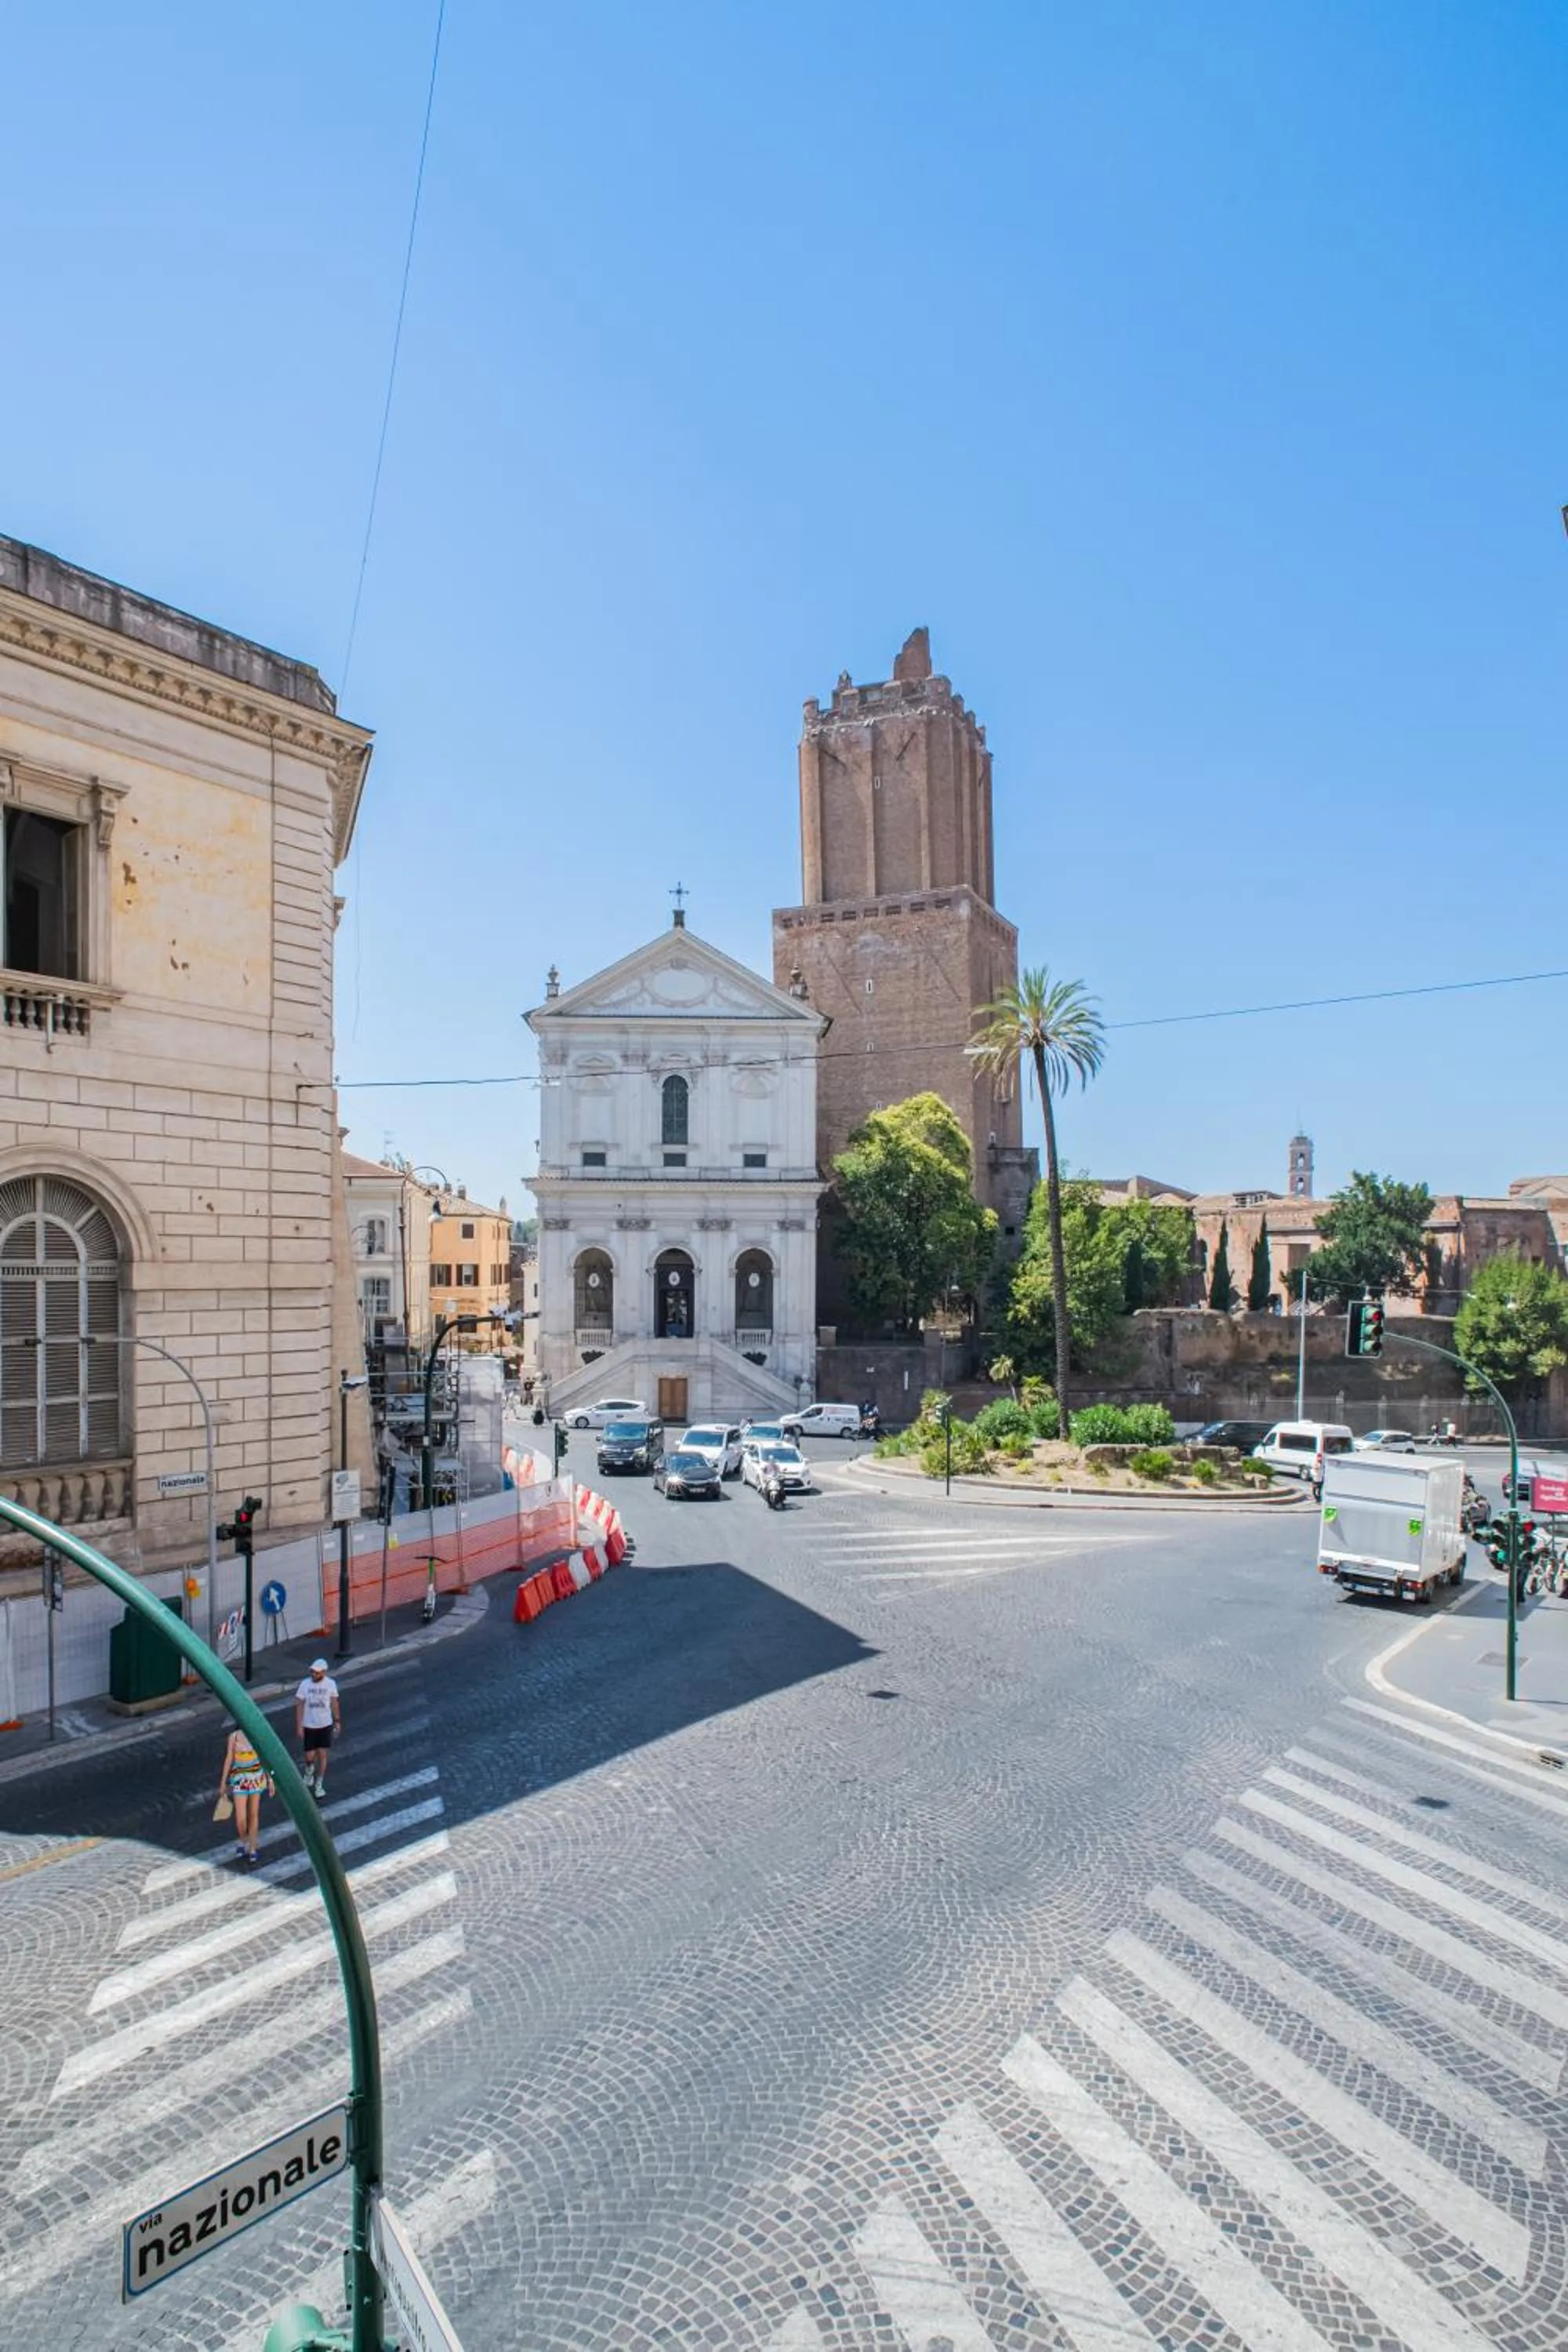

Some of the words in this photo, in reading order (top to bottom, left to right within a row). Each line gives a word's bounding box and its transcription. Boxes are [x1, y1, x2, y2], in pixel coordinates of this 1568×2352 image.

[161, 1475, 205, 1487] nazionale
[139, 2135, 341, 2277] nazionale
[140, 2212, 162, 2234] via
